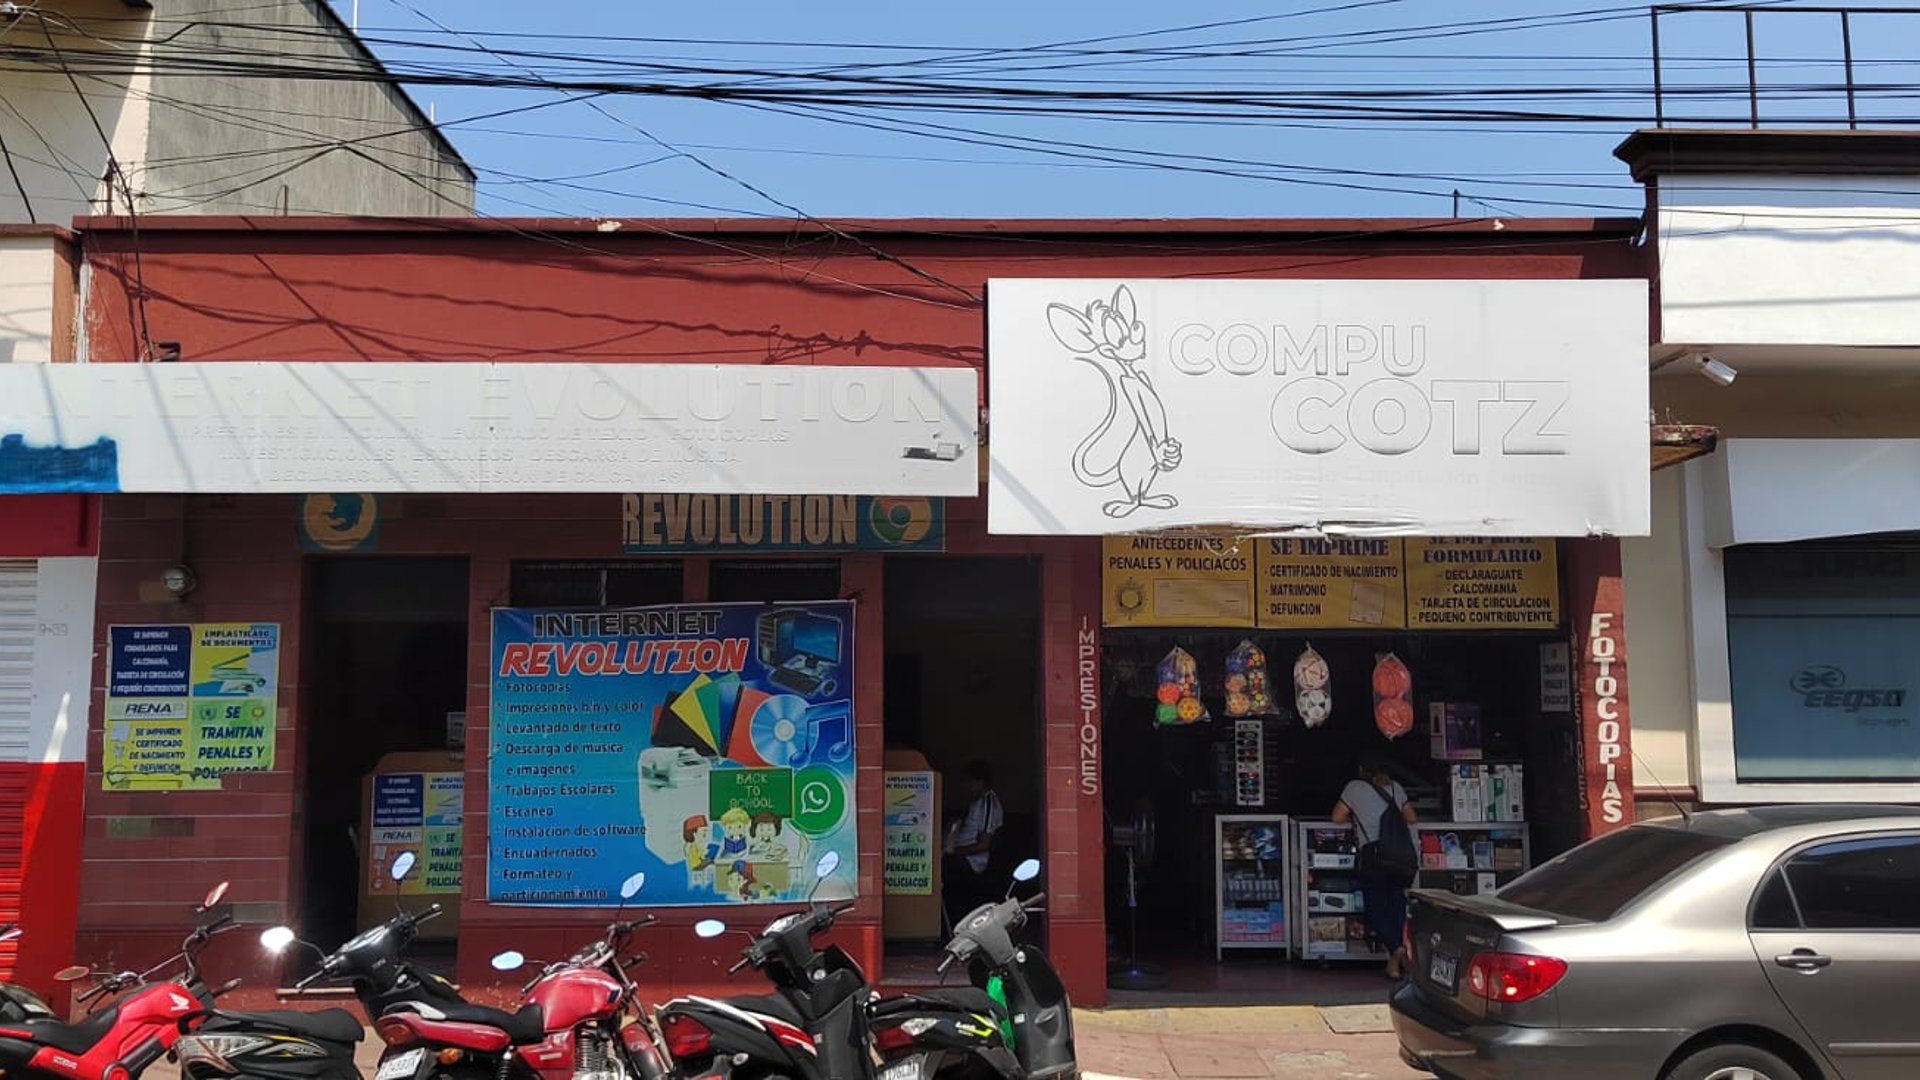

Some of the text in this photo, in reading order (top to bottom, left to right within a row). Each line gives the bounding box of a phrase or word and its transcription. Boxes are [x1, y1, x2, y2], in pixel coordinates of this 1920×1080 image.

[1168, 323, 1427, 376] COMPU
[14, 369, 943, 424] NTERNET EVOLUTION
[1270, 376, 1571, 455] COTZ
[622, 494, 857, 546] REVOLUTION
[1131, 538, 1223, 550] ANTECEDENTES
[1270, 538, 1389, 556] SE IMPRIME
[1424, 550, 1542, 563] FORMULARIO
[1109, 557, 1246, 571] PENALES Y POLICIACOS
[1269, 565, 1398, 578] CERTIFICADO DE NACIMIENTO
[1445, 569, 1523, 580] DECLARAGUATE
[1270, 585, 1326, 597] MATRIMONIO
[1270, 603, 1322, 615] DEFUNCION
[1422, 598, 1464, 609] TARJETA
[1467, 598, 1480, 608] DE
[1469, 612, 1554, 622] CONTRIBUYENTE
[533, 610, 723, 638] INTERNET
[500, 638, 750, 677] REVOLUTION
[505, 682, 571, 694] Fotocopias
[1078, 615, 1098, 795] IMPRESIONES
[1803, 689, 1907, 712] eegsa
[225, 706, 241, 719] SE
[506, 703, 578, 715] Impresiones
[1590, 612, 1623, 823] FOTOCOPIAS
[201, 726, 264, 739] TRAMITAN
[506, 721, 622, 734] Levantado de texto
[198, 746, 265, 759] PENALES Y
[506, 743, 561, 756] Descarga
[564, 742, 579, 753] de
[506, 764, 576, 777] e imagenes
[736, 773, 768, 784] BACK
[505, 783, 615, 798] Trabajos Escolares
[745, 785, 761, 797] TO
[504, 805, 554, 817] Escaneo
[573, 824, 591, 836] de
[593, 824, 646, 836] software
[431, 847, 463, 858] TRAMITA
[504, 847, 597, 860] Encuadernados
[503, 867, 573, 880] Formateo y
[426, 877, 463, 887] POLICIAC
